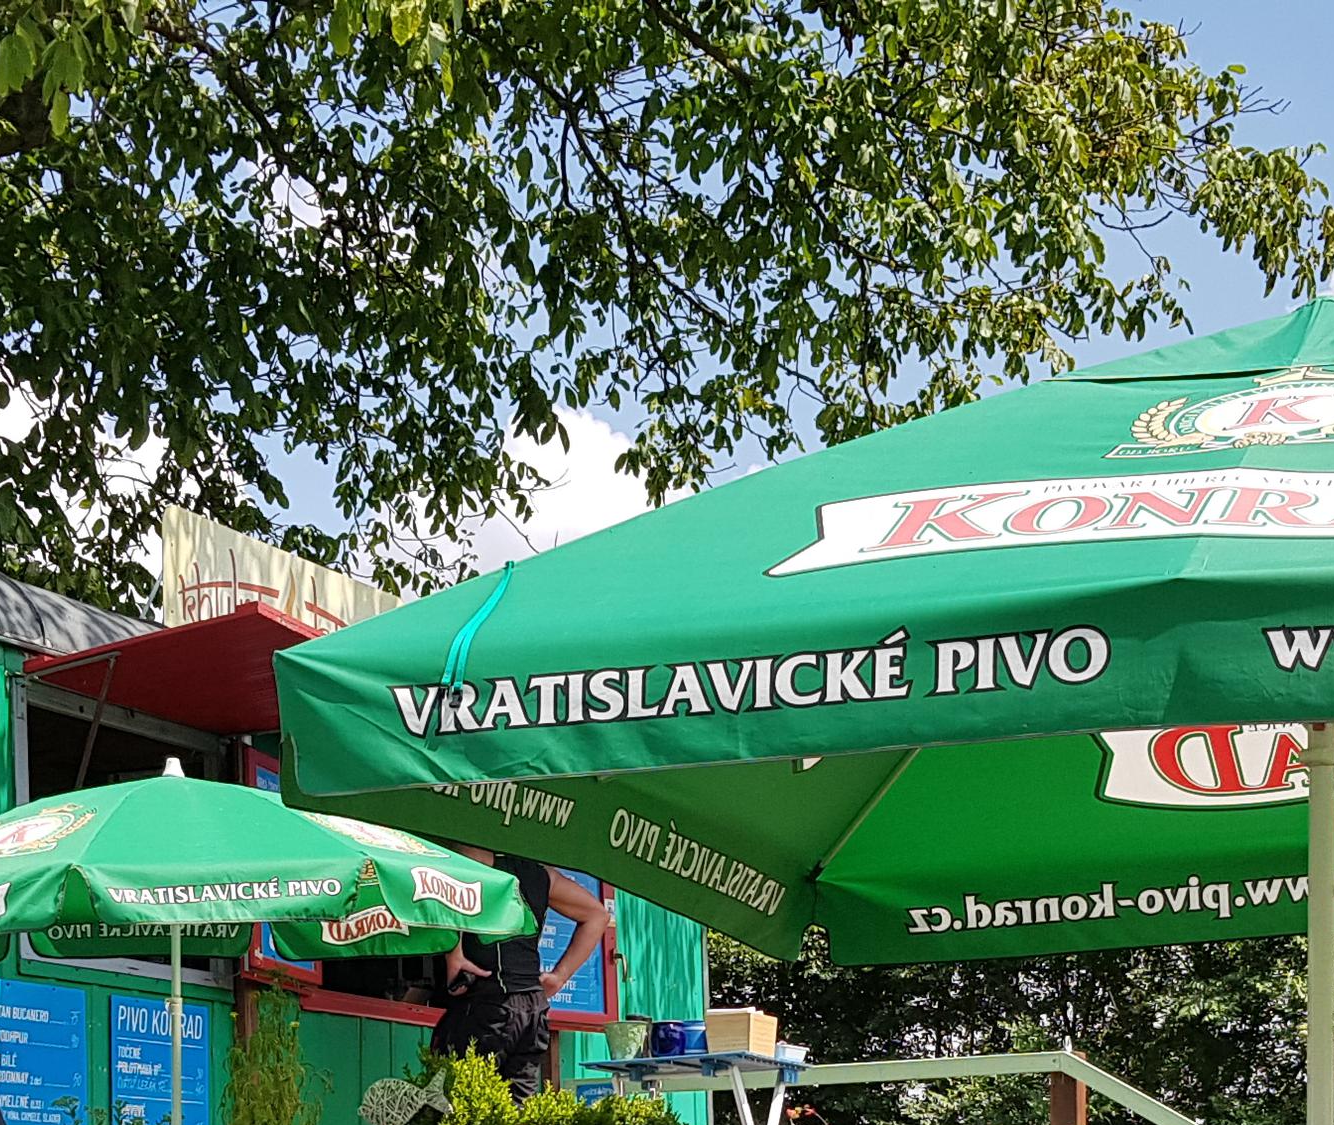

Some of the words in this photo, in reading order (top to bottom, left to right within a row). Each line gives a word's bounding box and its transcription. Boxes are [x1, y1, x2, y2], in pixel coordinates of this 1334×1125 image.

[1223, 394, 1334, 431] K
[393, 628, 910, 735] VRATISLAVICKÉ
[931, 625, 1112, 697] PIVO
[108, 877, 281, 905] VRATISLAVICKÉ
[286, 877, 341, 897] PIVO
[419, 869, 478, 914] KONRAD
[118, 1005, 148, 1033] PIVO
